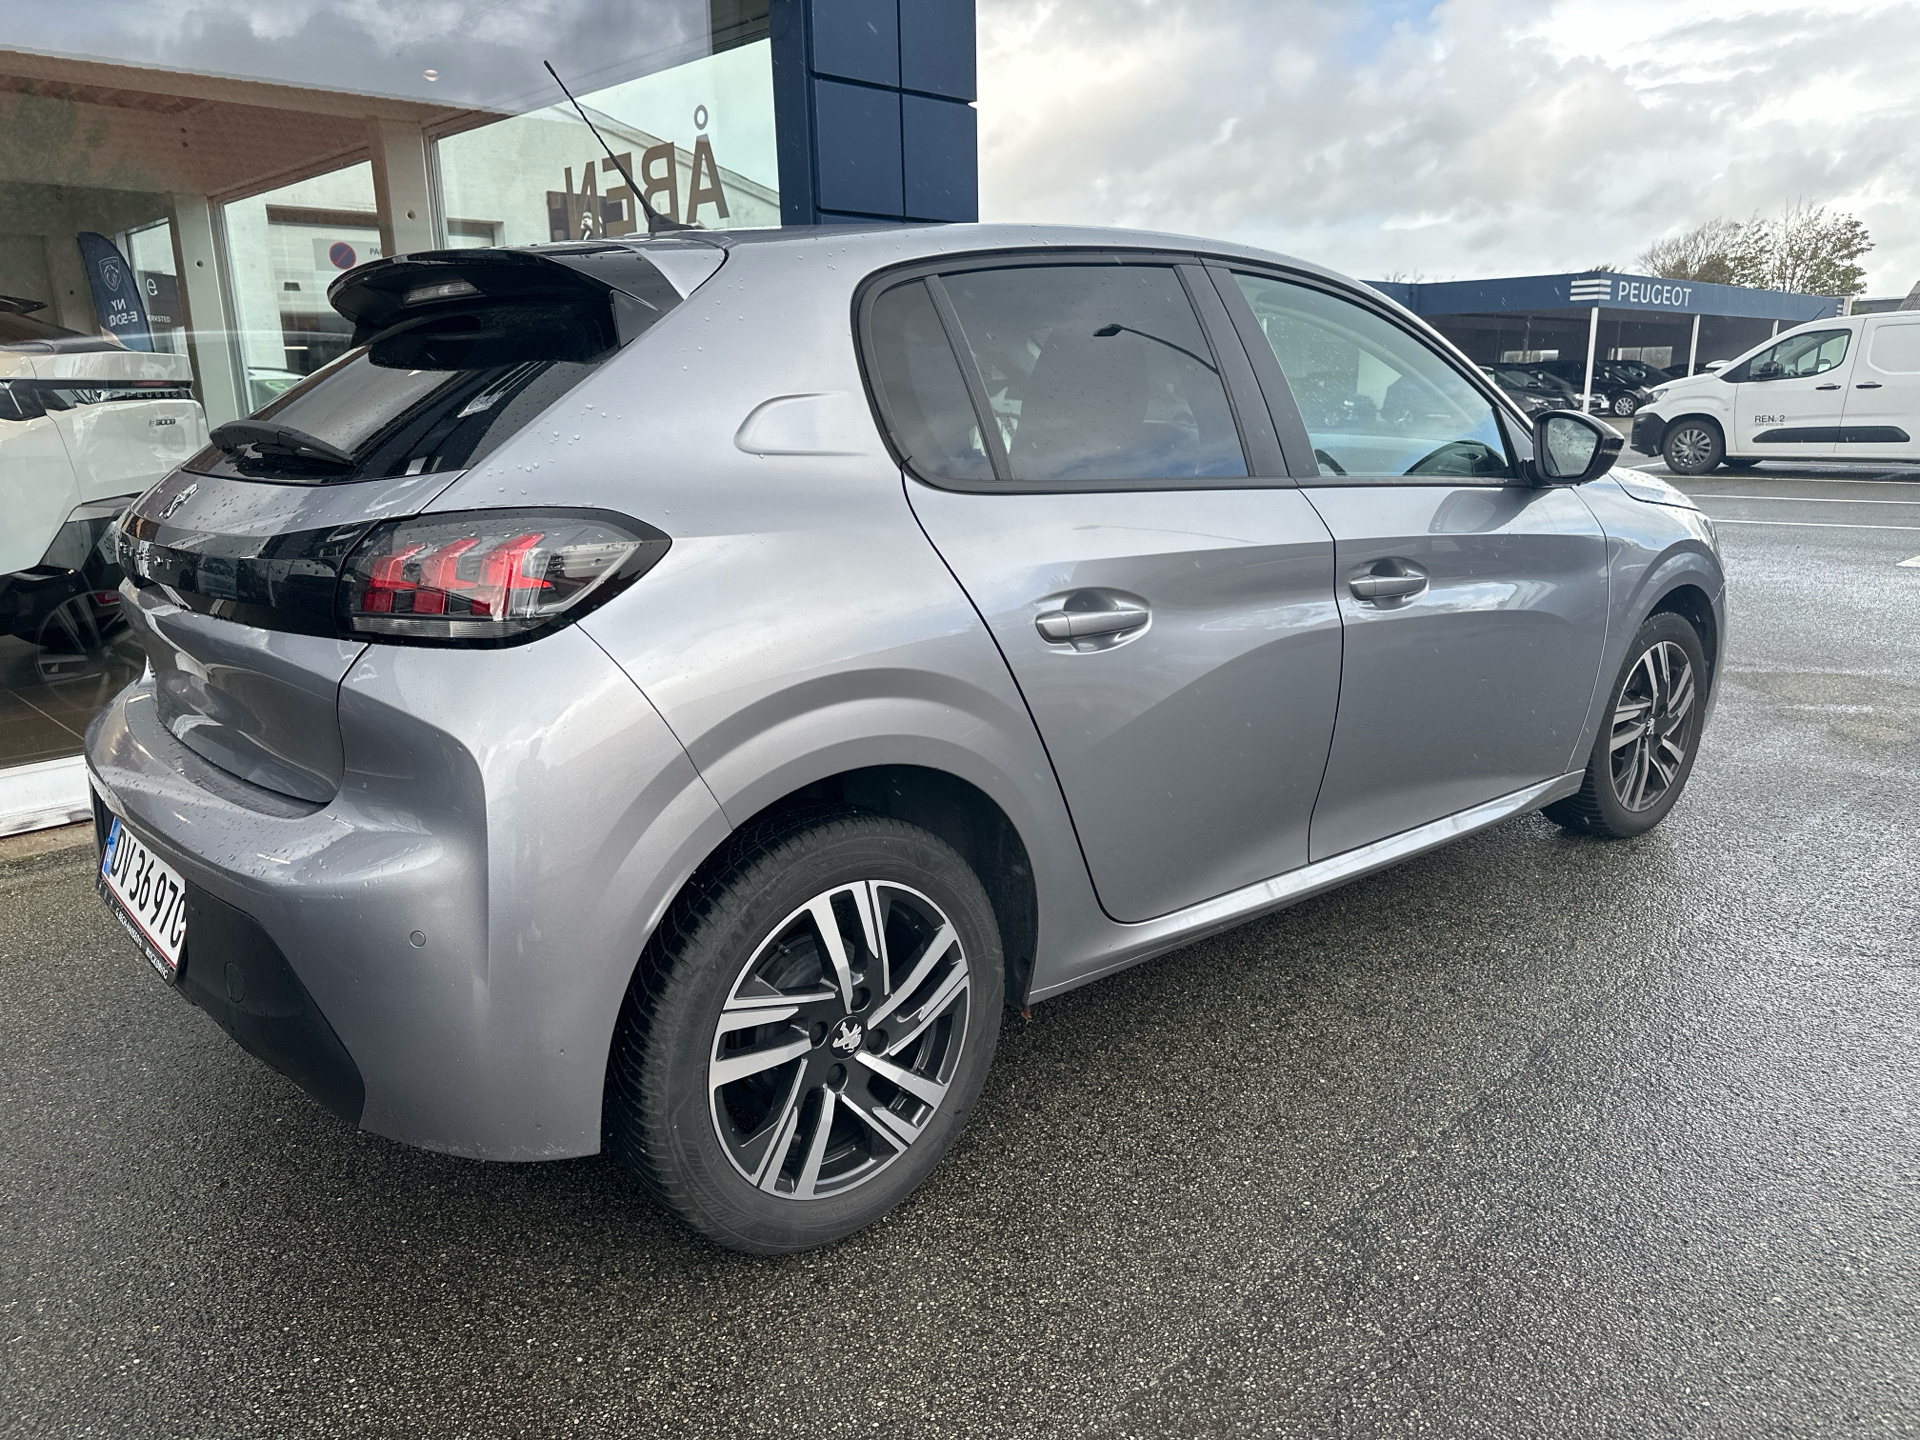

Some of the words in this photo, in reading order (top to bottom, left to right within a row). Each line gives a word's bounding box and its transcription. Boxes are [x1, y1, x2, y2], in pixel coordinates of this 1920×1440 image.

[370, 247, 382, 256] PA
[1618, 281, 1692, 307] PEUGEOT
[1779, 414, 1785, 422] 2
[110, 828, 137, 888] DV
[129, 849, 155, 912] 36
